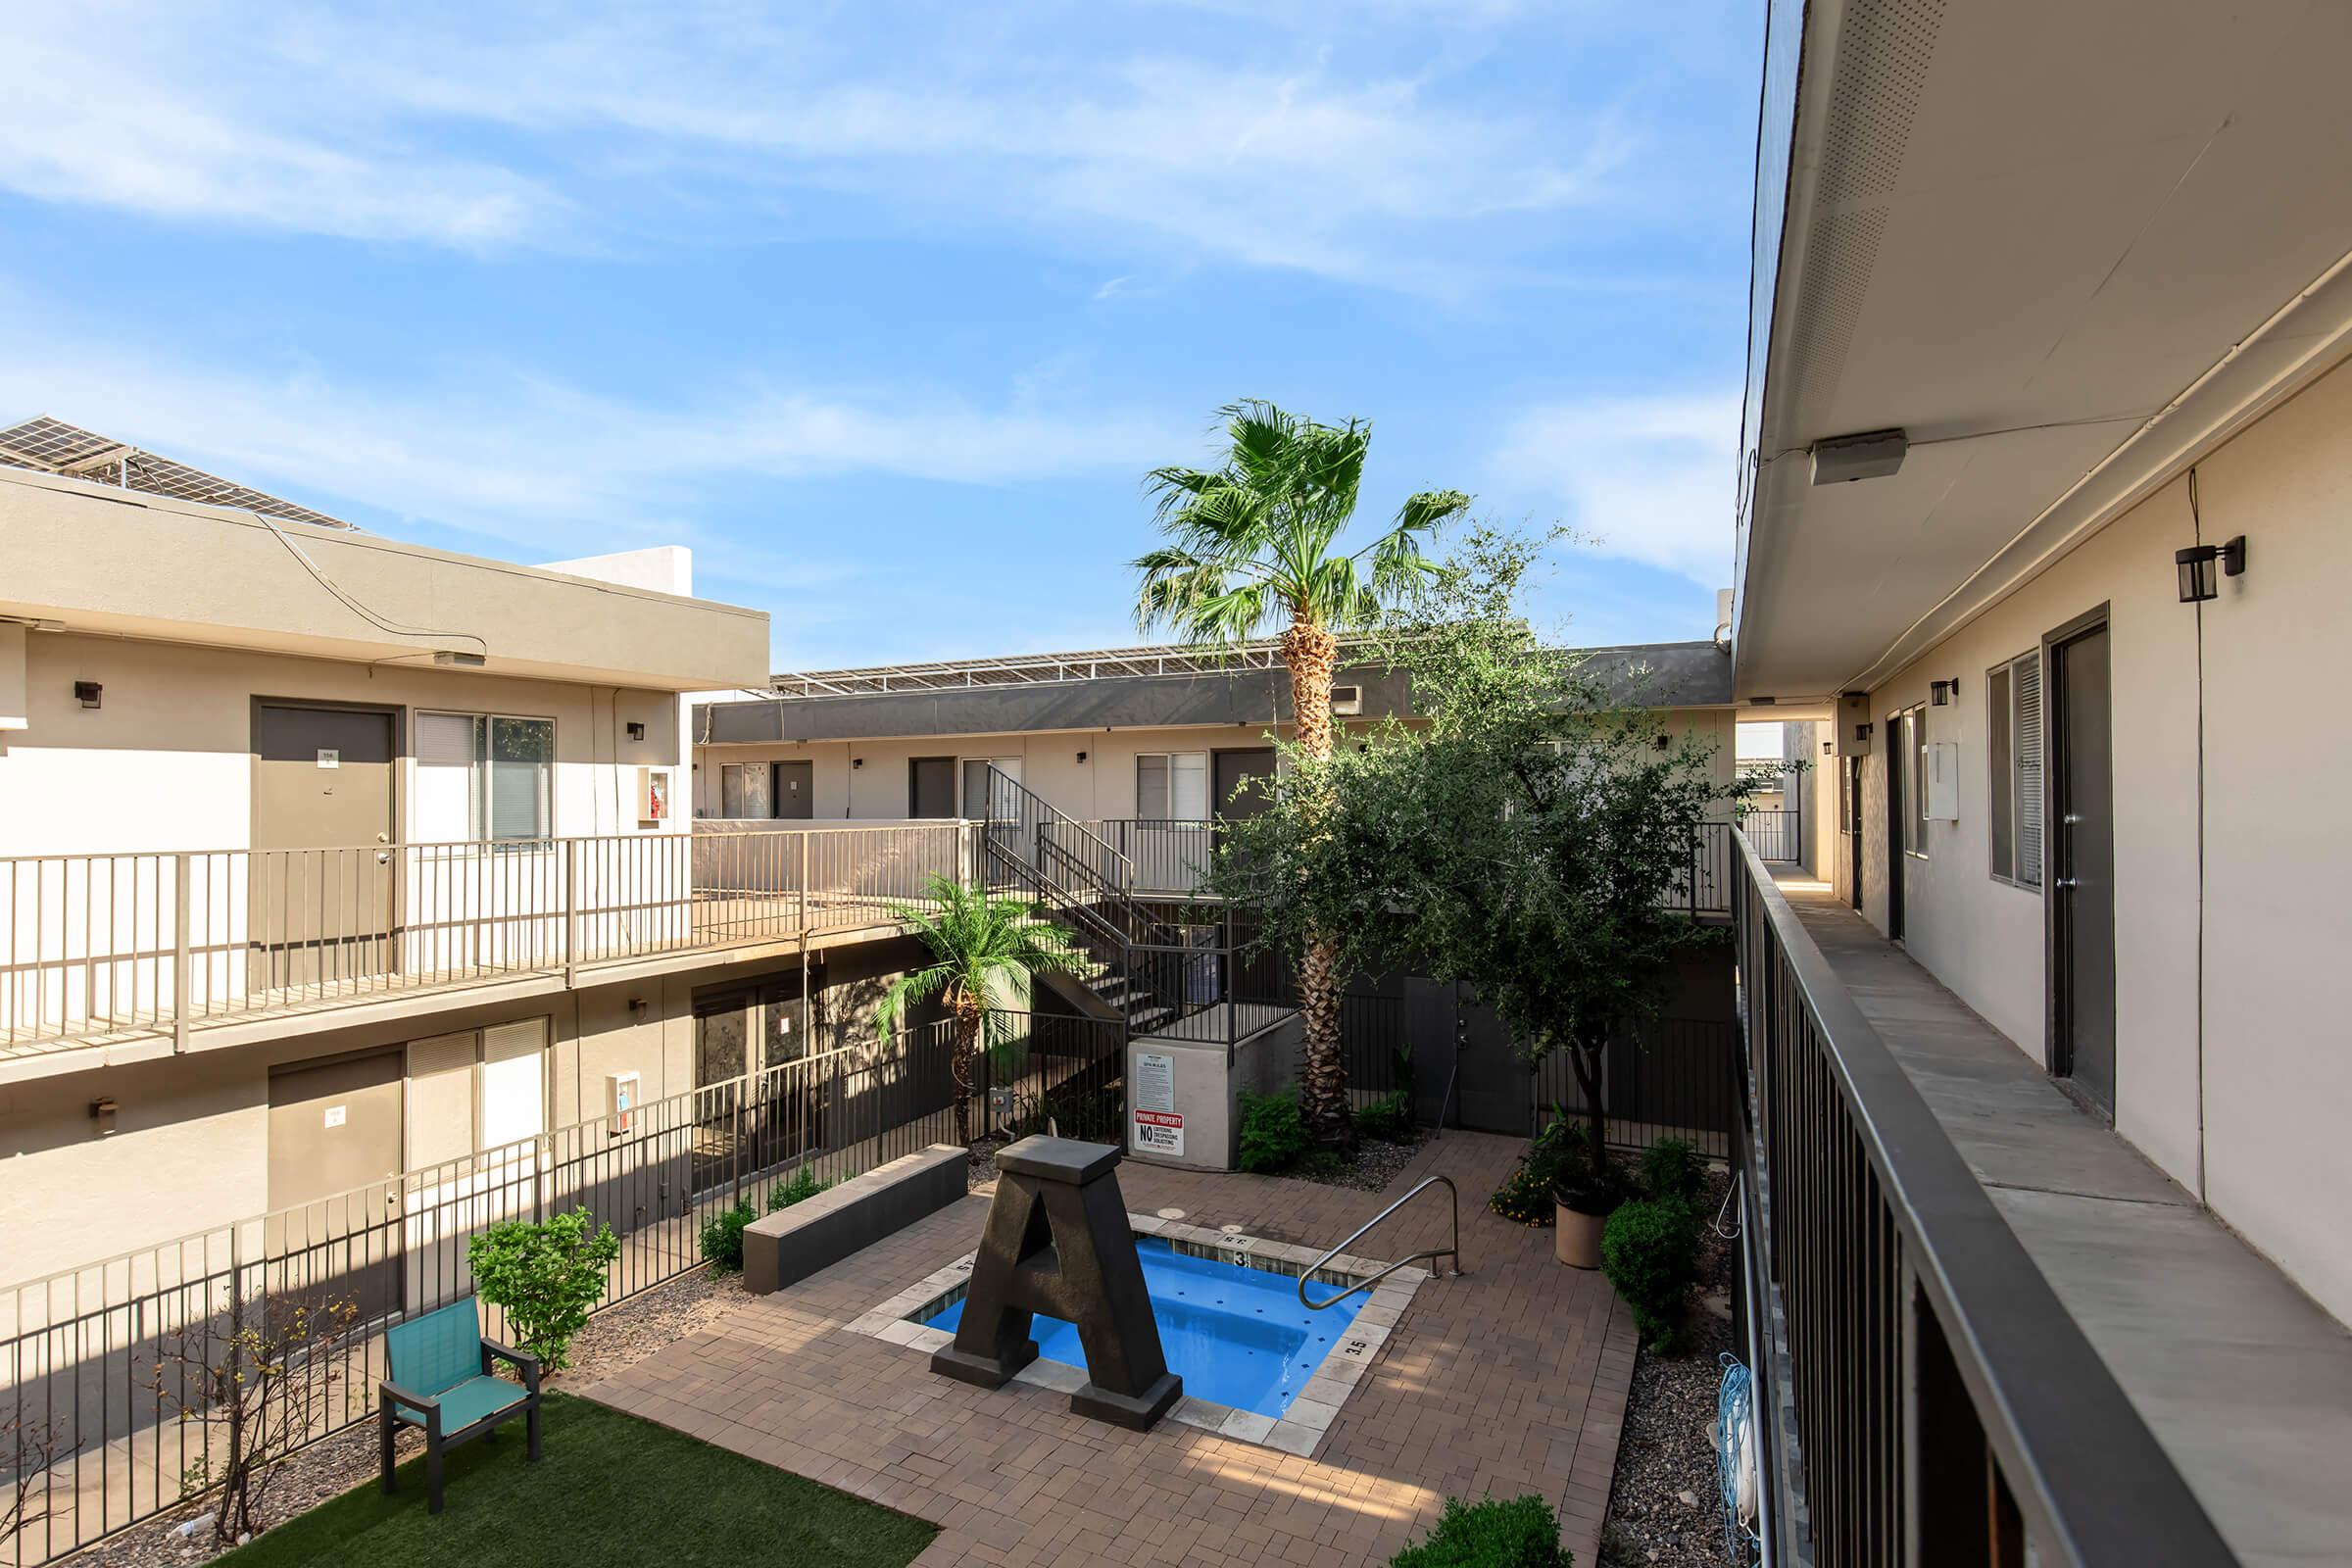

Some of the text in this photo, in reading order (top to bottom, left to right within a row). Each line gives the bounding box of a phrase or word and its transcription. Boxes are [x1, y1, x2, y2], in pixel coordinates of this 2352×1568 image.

[1136, 1112, 1182, 1126] PRIVATE PROPERTY
[1140, 1125, 1152, 1142] NO
[929, 1134, 1183, 1433] A
[1345, 1341, 1367, 1356] 3.5
